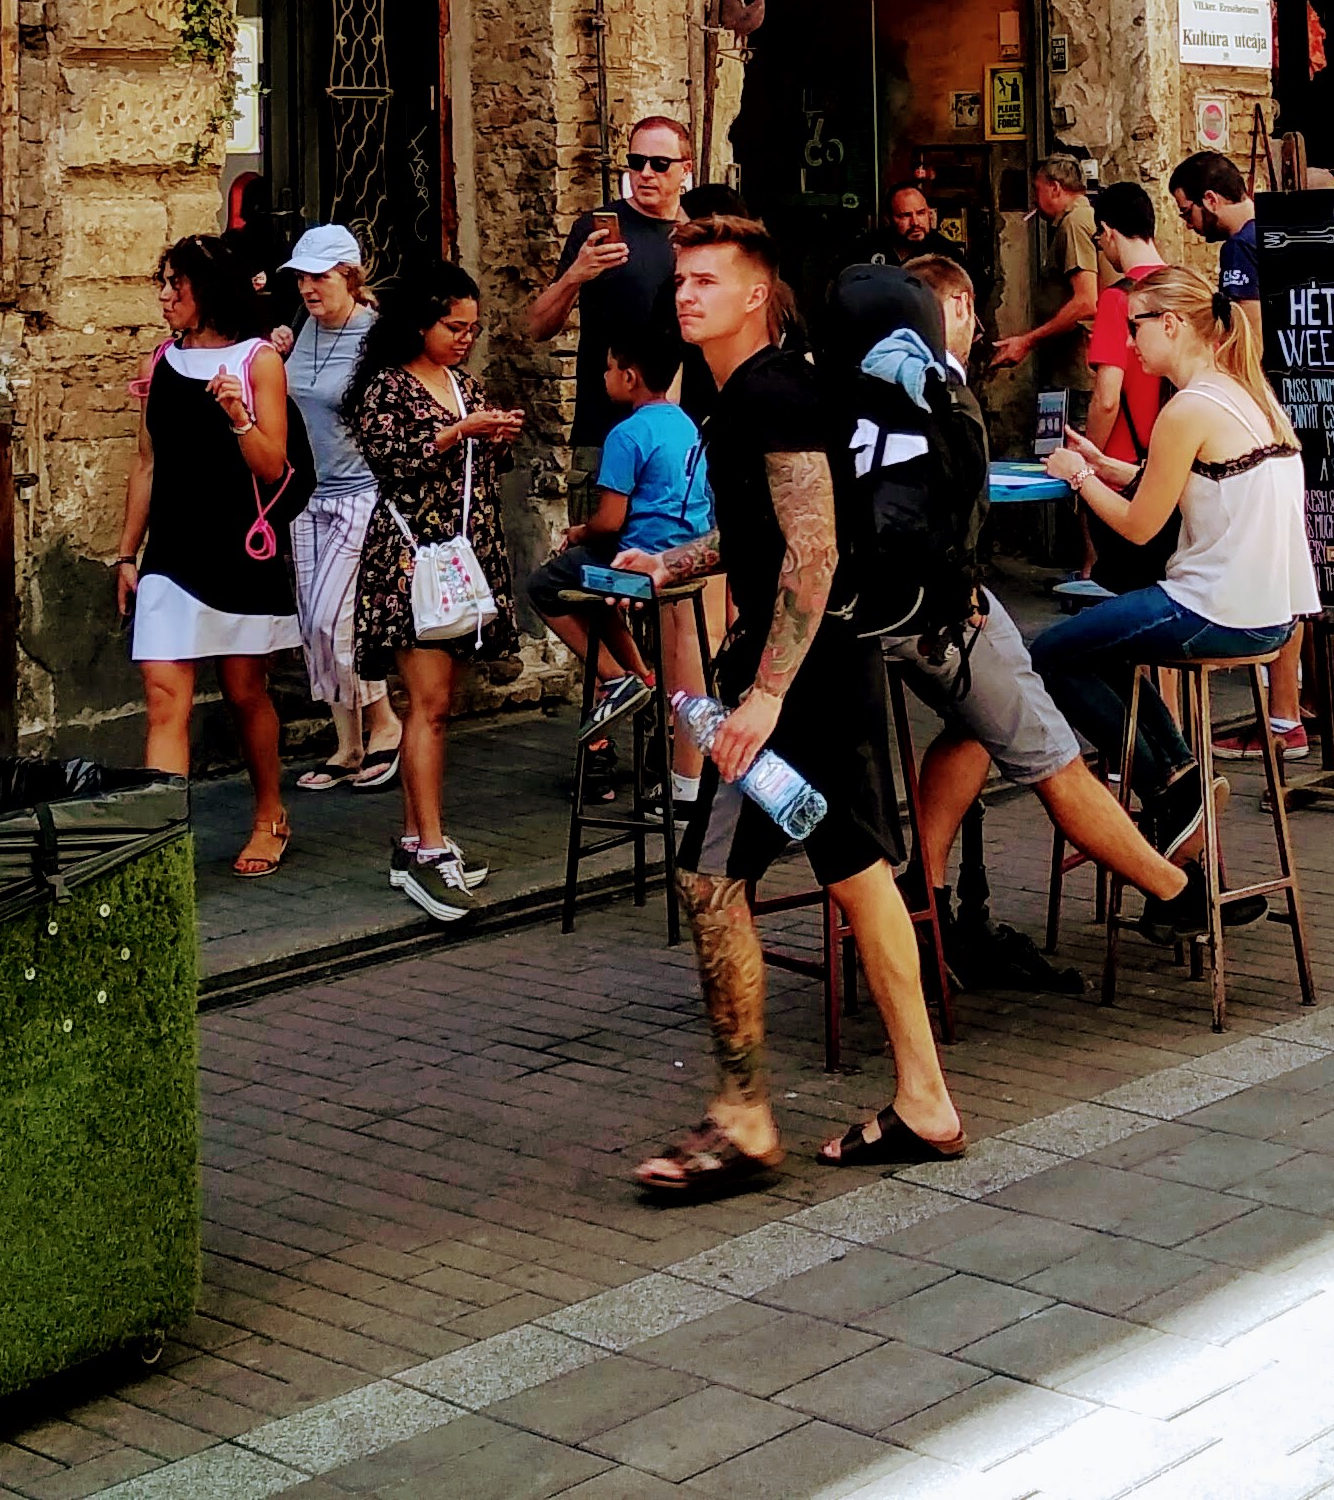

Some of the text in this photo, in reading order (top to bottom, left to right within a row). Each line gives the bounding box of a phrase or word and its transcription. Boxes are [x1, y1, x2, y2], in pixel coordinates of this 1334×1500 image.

[1183, 28, 1267, 53] Kultúra utcája
[997, 104, 1021, 113] PLEASE
[998, 119, 1021, 129] FORCE
[1320, 458, 1329, 481] A
[1305, 490, 1328, 513] RESH
